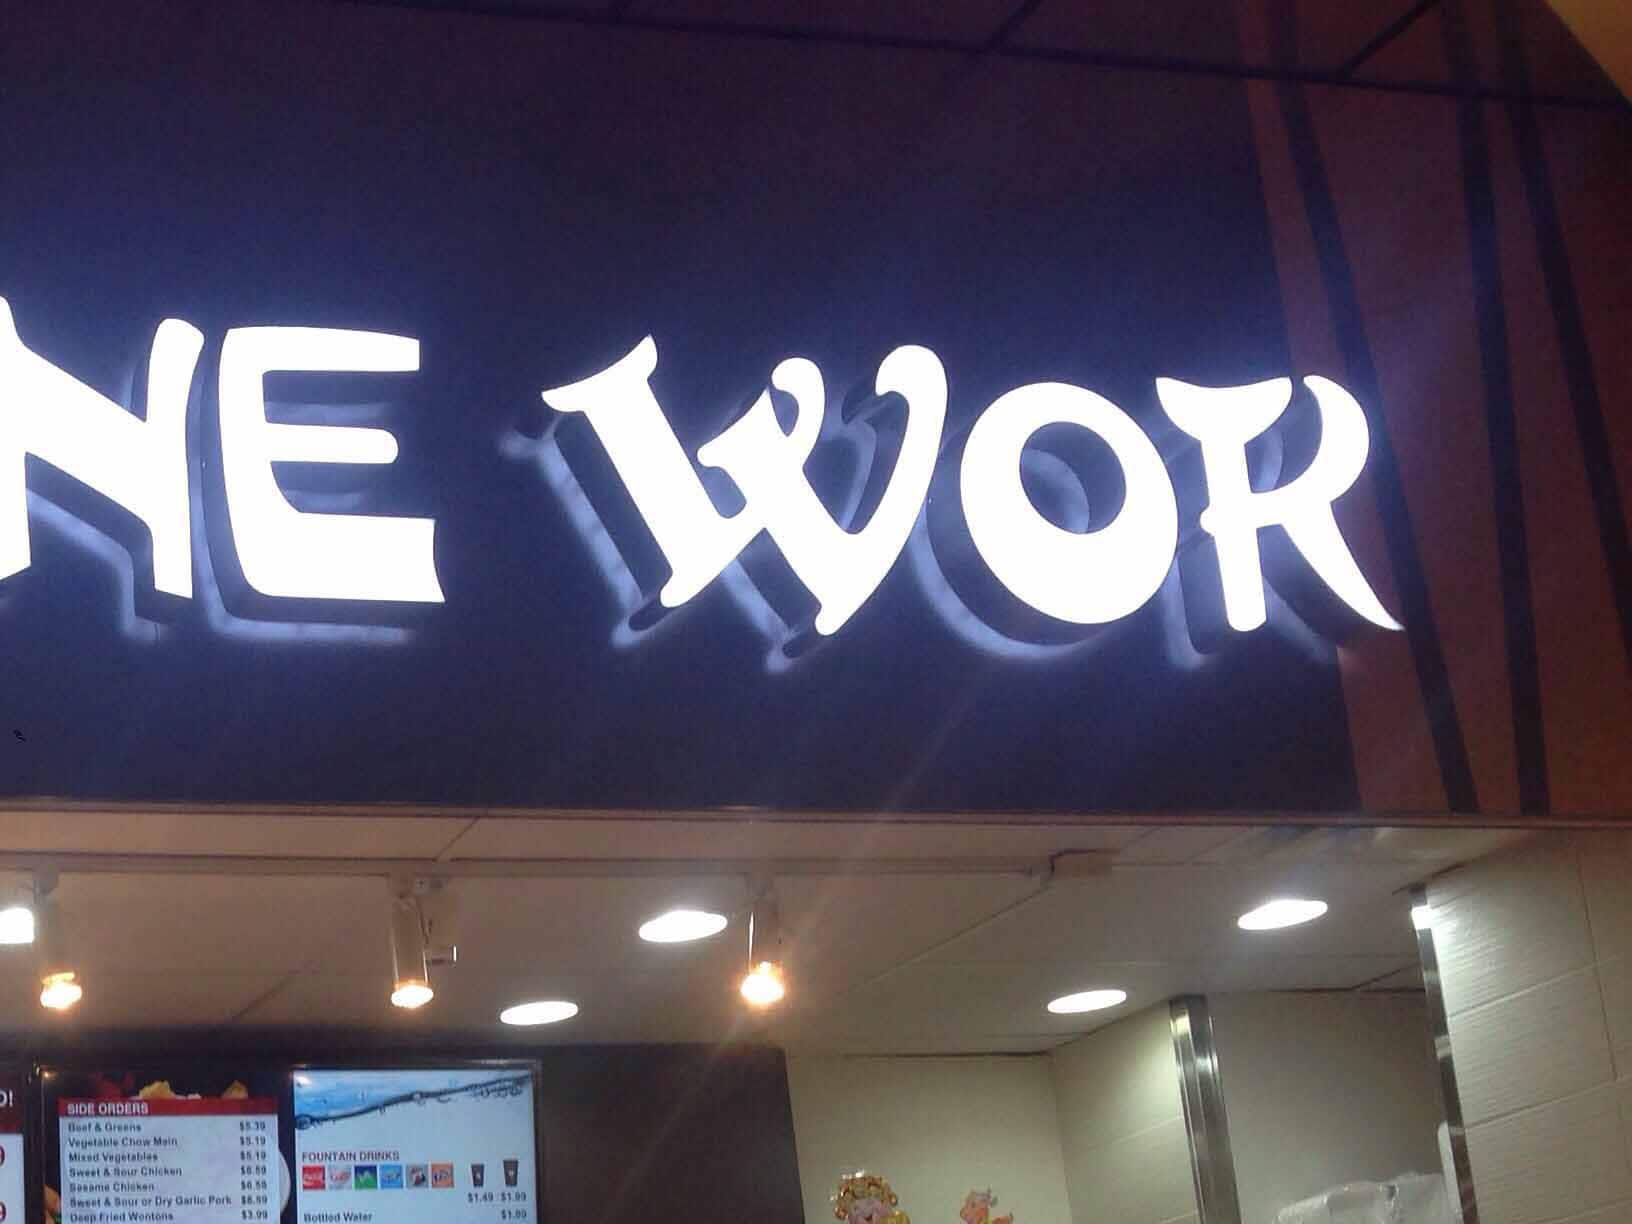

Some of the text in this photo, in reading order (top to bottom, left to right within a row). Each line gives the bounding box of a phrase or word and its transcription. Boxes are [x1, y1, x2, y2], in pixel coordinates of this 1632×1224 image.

[67, 1102, 149, 1115] SIDE ORDERS
[67, 1137, 119, 1149] Vegetable
[121, 1136, 151, 1147] Chow
[68, 1152, 100, 1162] Mixed
[102, 1151, 159, 1164] Vegetables
[301, 1151, 401, 1162] FOUNTAIN DRINKS
[69, 1167, 101, 1178] Sweet
[140, 1166, 183, 1177] Chicken
[112, 1182, 155, 1193] Chicken
[70, 1213, 97, 1224] Deep
[99, 1212, 126, 1222] Fried
[303, 1212, 341, 1223] Bottled
[343, 1211, 373, 1222] Water
